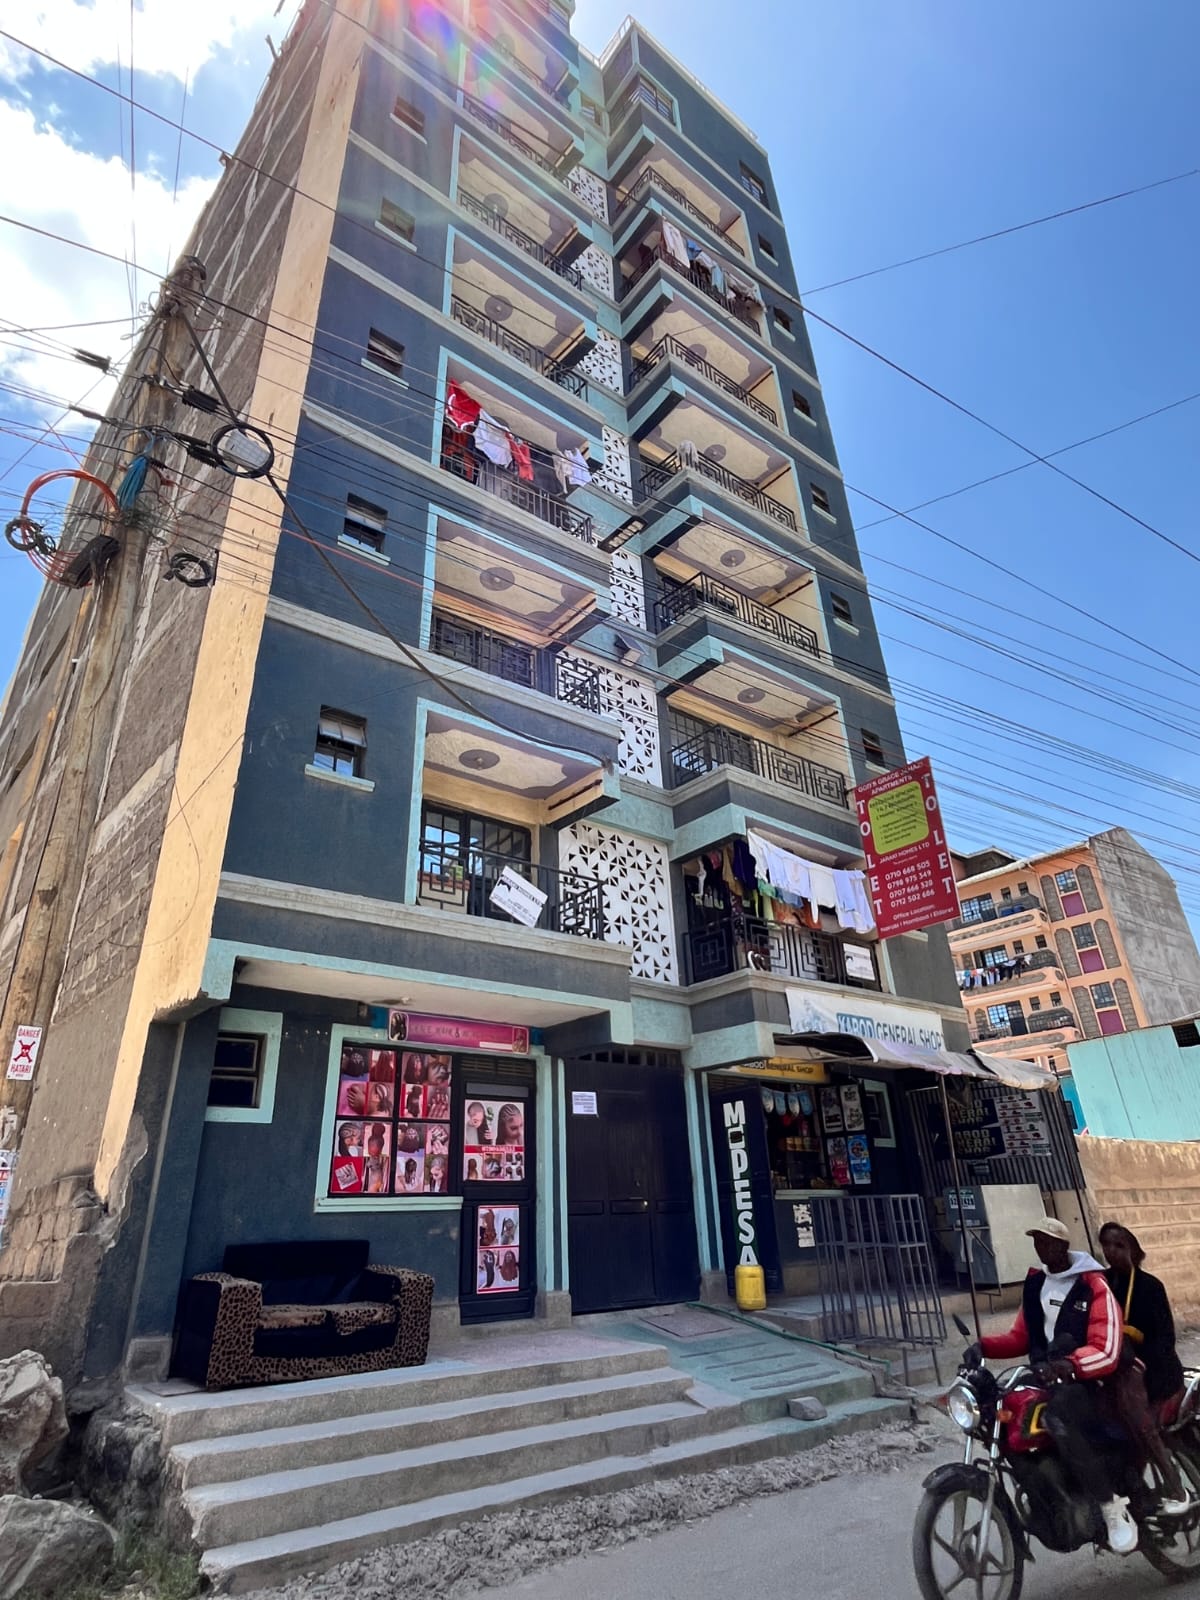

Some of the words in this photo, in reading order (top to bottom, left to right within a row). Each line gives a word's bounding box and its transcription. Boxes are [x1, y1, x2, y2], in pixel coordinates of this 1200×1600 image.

[871, 775, 913, 795] APARTMENTS
[877, 772, 900, 785] GRACE
[918, 842, 930, 851] LTD
[885, 870, 902, 881] 0710
[902, 865, 916, 875] 668
[917, 860, 930, 870] 505
[887, 879, 904, 889] 0798
[904, 874, 918, 884] 975
[918, 870, 932, 880] 349
[889, 888, 906, 899] 0707
[890, 897, 906, 908] 0712
[907, 893, 921, 903] 502
[893, 910, 910, 920] Office
[18, 1028, 41, 1038] DANGER
